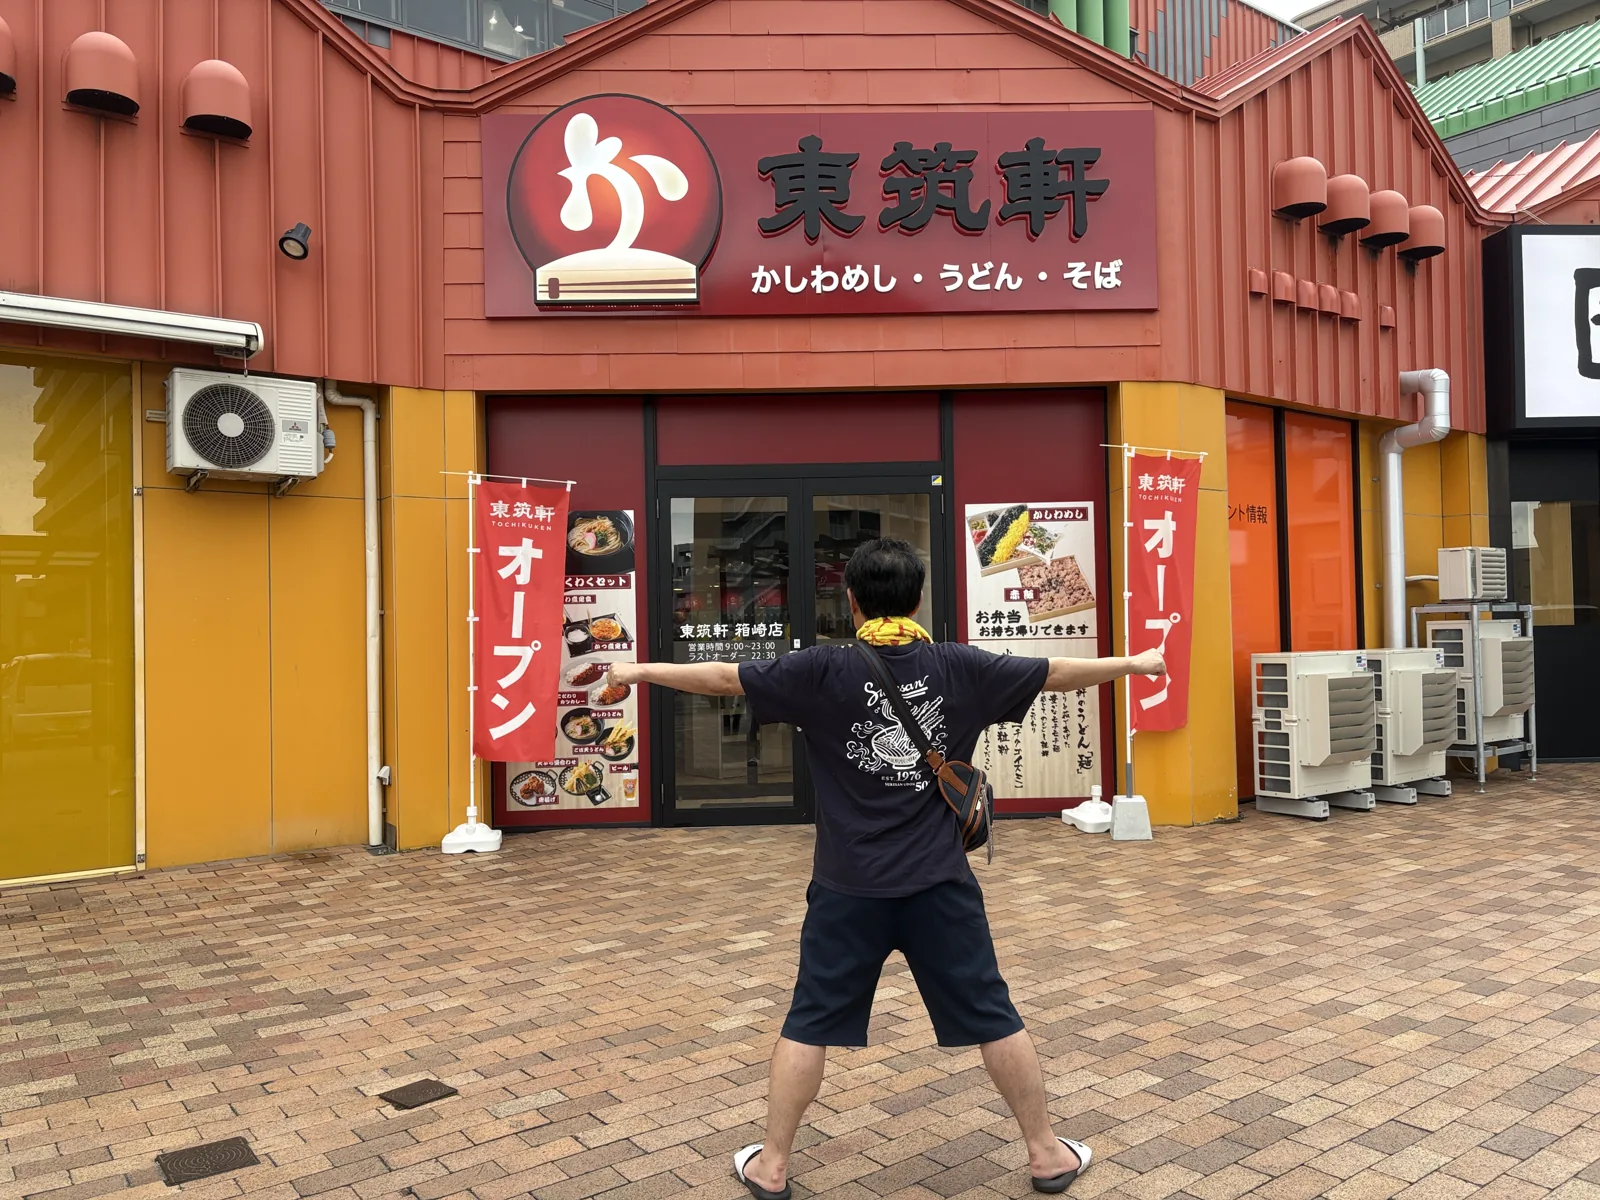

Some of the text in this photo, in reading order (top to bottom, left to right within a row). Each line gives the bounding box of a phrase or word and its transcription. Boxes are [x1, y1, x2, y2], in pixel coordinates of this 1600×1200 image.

[757, 136, 1110, 240] 東筑軒
[1137, 472, 1186, 494] 東筑軒
[489, 500, 555, 523] 東筑軒
[1032, 509, 1084, 520] かしわめし
[491, 520, 552, 531] TOCHIKUKEN
[1009, 588, 1035, 600] 赤飯
[975, 609, 1022, 625] お弁当
[680, 622, 784, 639] 東筑軒 箱崎店
[978, 623, 1089, 638] お持ち帰りできます
[488, 537, 543, 741] オープン
[687, 642, 723, 652] 営業時間
[688, 651, 776, 661] ラストオーダー 22:30
[896, 769, 922, 782] 1976
